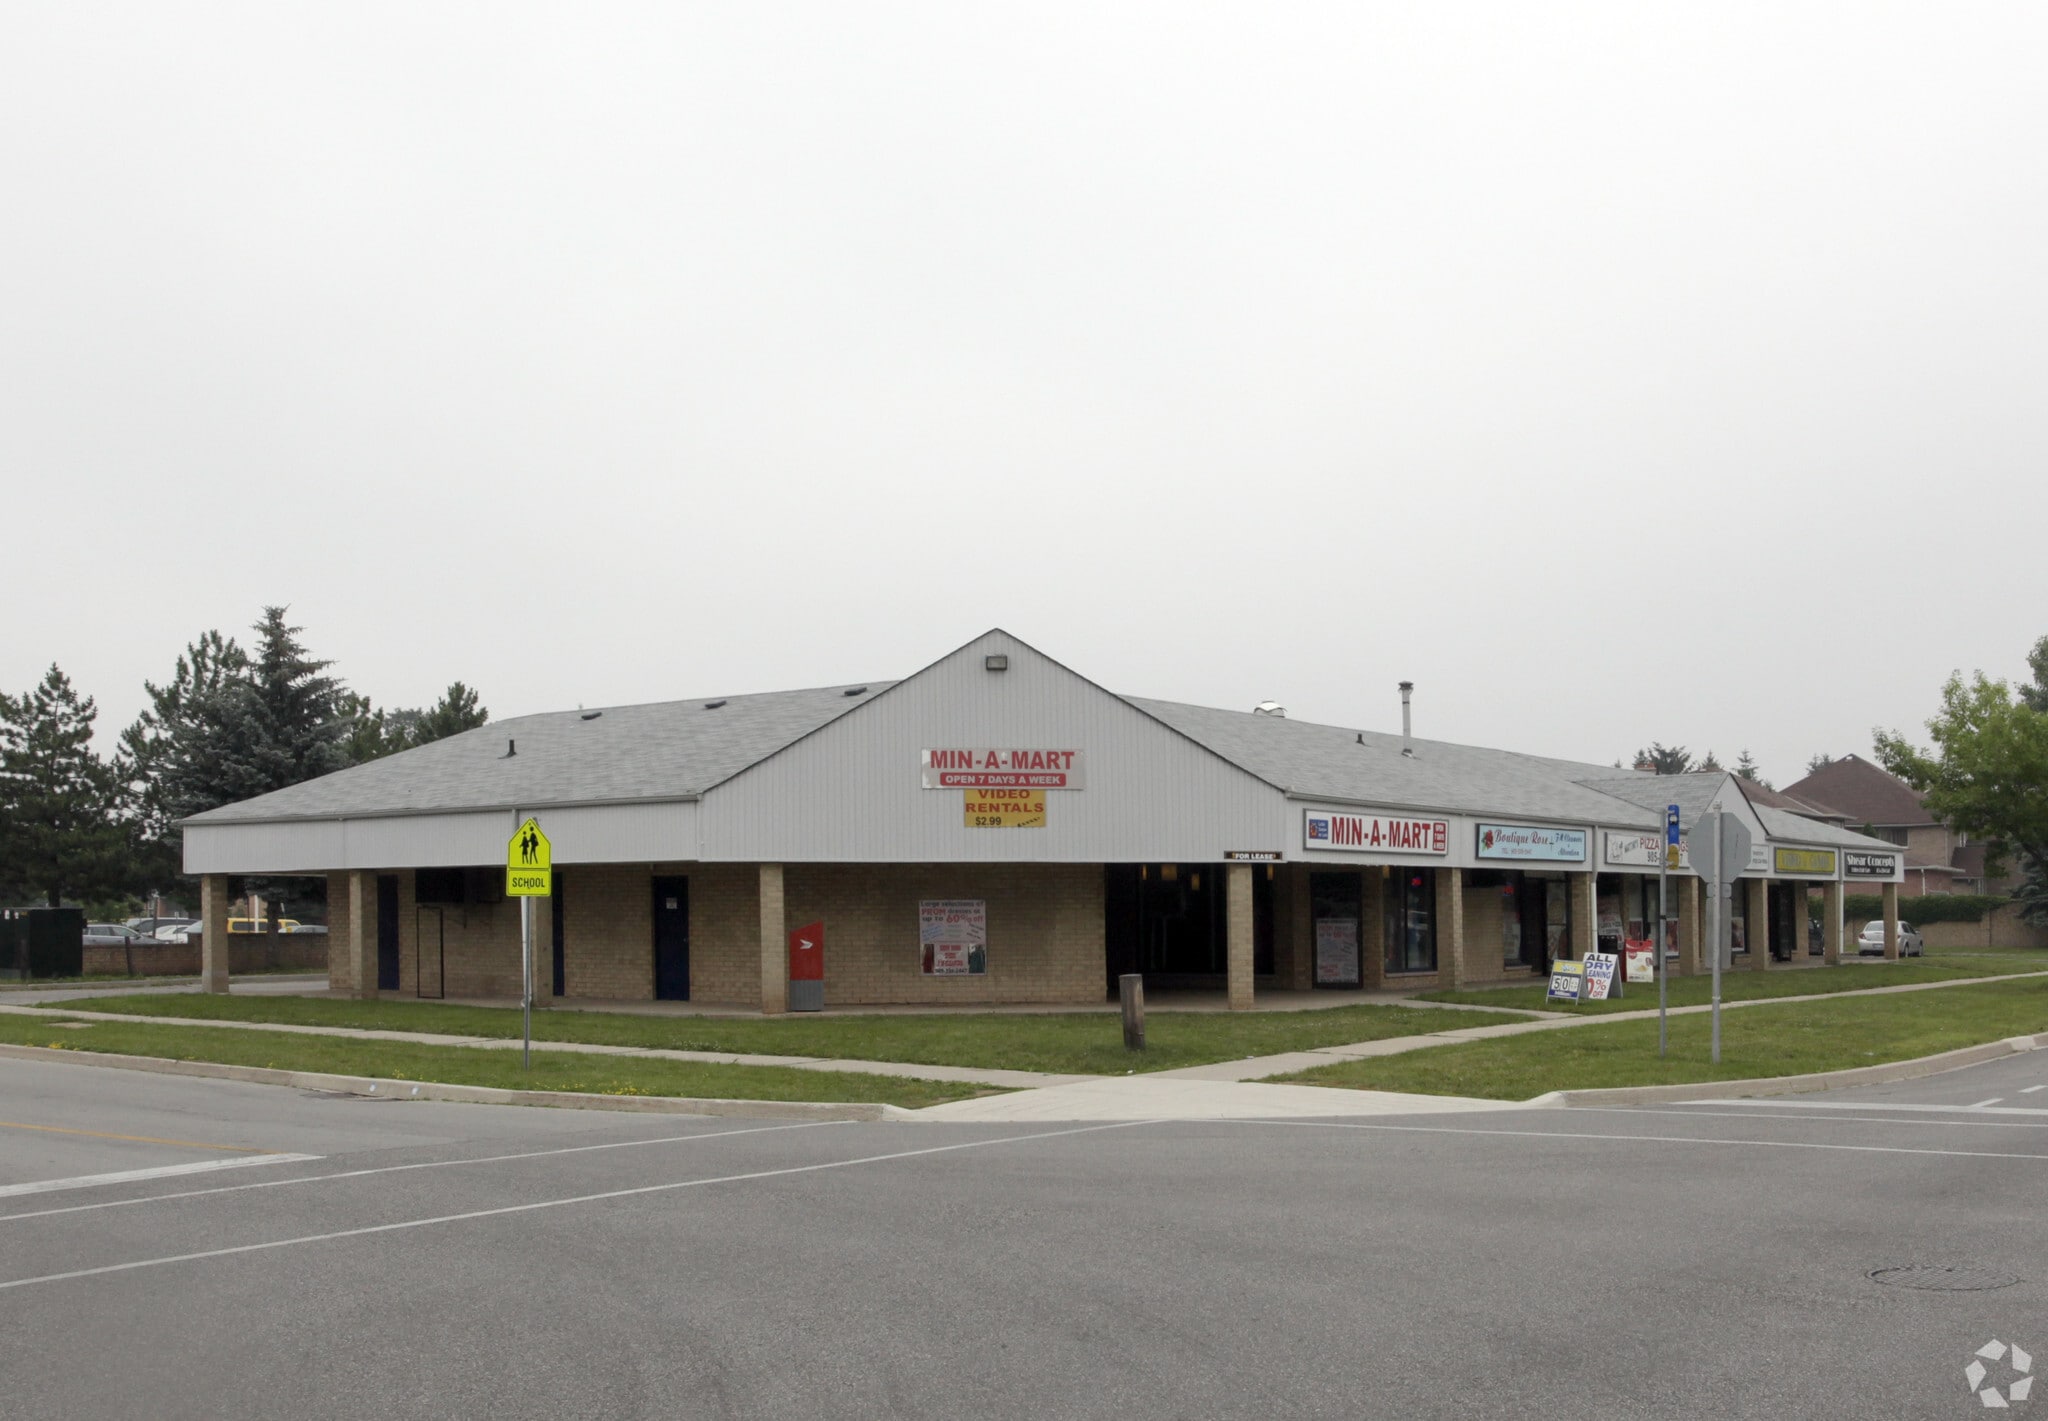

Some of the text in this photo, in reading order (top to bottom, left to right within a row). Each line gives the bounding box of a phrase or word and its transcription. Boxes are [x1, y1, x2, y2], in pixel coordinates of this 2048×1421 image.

[930, 750, 1075, 770] MIN-A-MART
[945, 775, 1061, 785] OPEN 7 DAYS A WEEK
[978, 789, 1031, 799] VIDEO
[965, 803, 1044, 813] RENTALS
[975, 816, 1002, 826] $2.99
[1331, 816, 1431, 849] MIN-A-MART
[1495, 829, 1529, 846] Boutique
[1530, 831, 1549, 845] Rose
[1640, 837, 1660, 850] PIZZA
[1847, 855, 1895, 867] Shear Concepts
[512, 877, 545, 888] SCHOOL
[946, 914, 972, 923] 60%
[1587, 953, 1613, 963] ALL
[1585, 961, 1613, 970] DRY
[1588, 970, 1611, 979] EANING
[1553, 978, 1569, 990] 50
[1592, 990, 1604, 998] OFF
